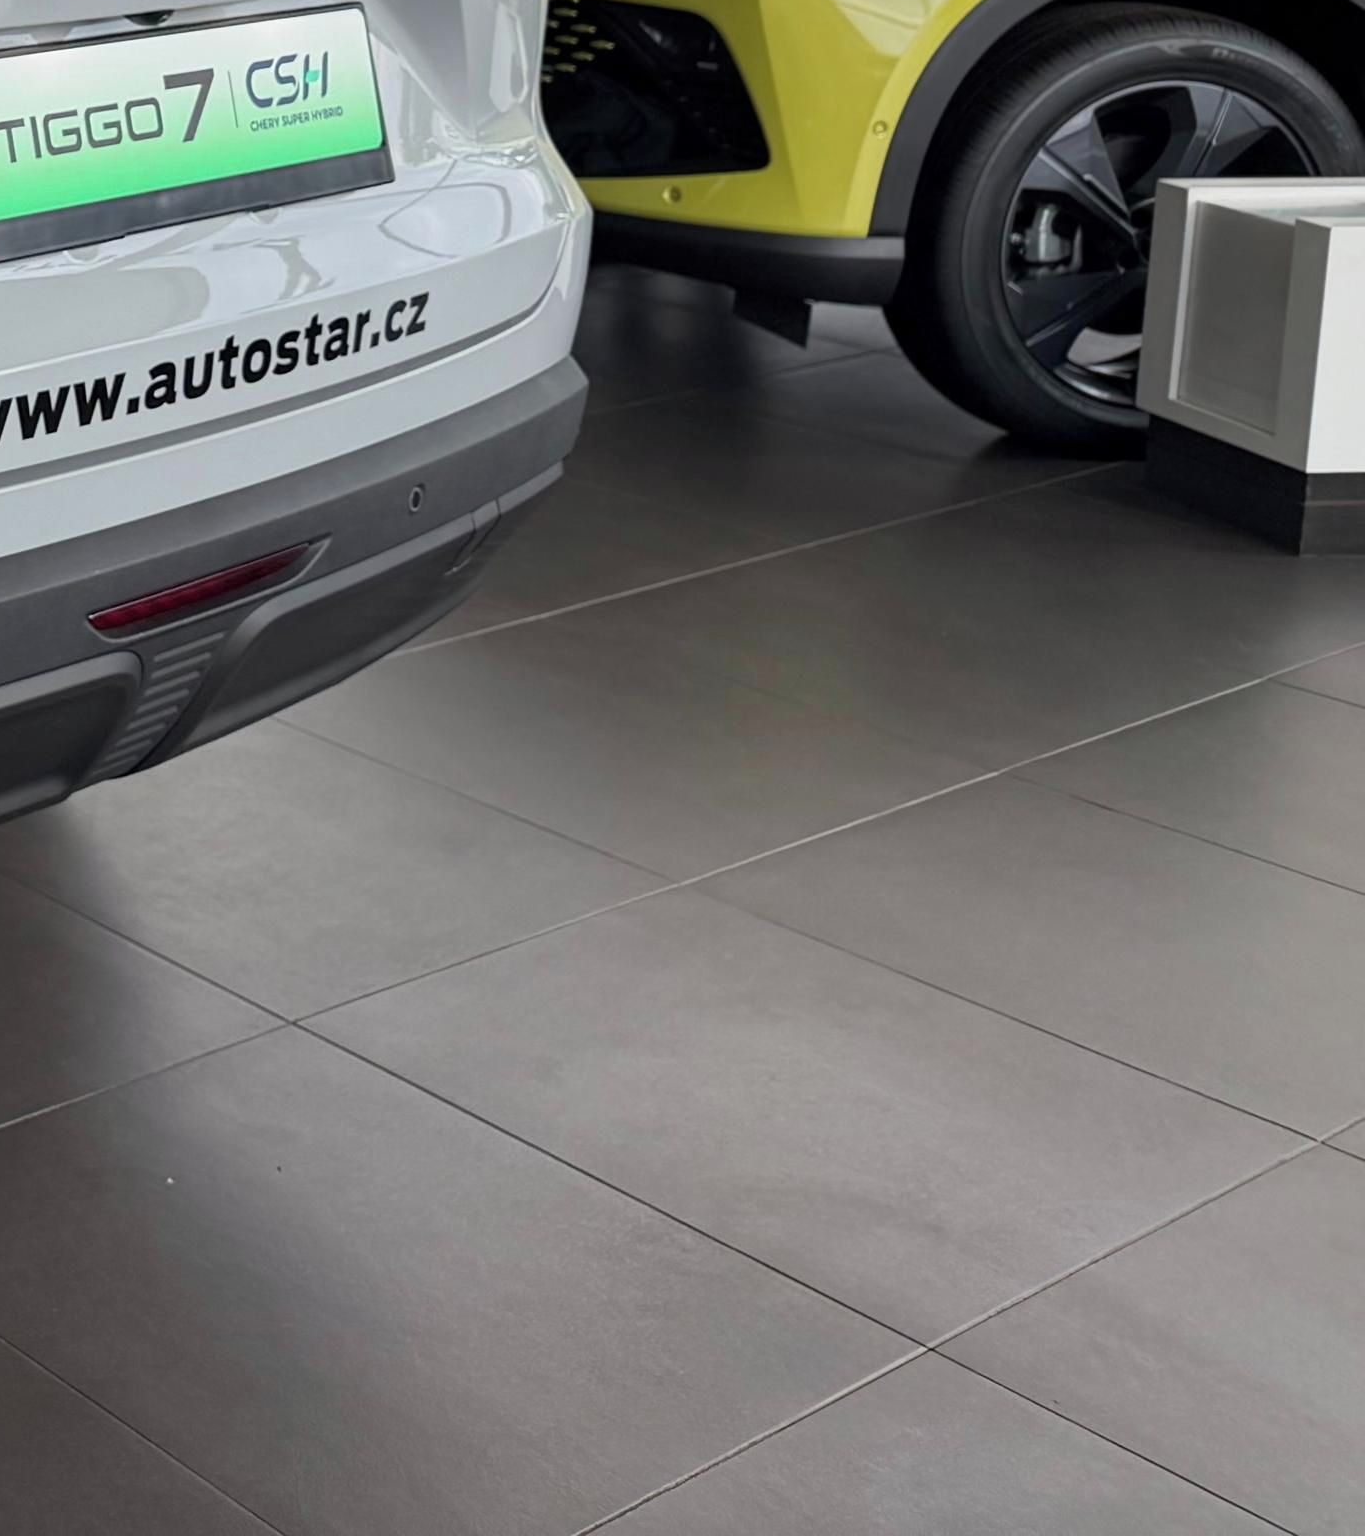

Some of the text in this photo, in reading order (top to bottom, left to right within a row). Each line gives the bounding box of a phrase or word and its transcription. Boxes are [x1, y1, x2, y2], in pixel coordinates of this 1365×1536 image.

[245, 51, 329, 109] CSH
[250, 105, 344, 132] CHERY SUPER HYBRID
